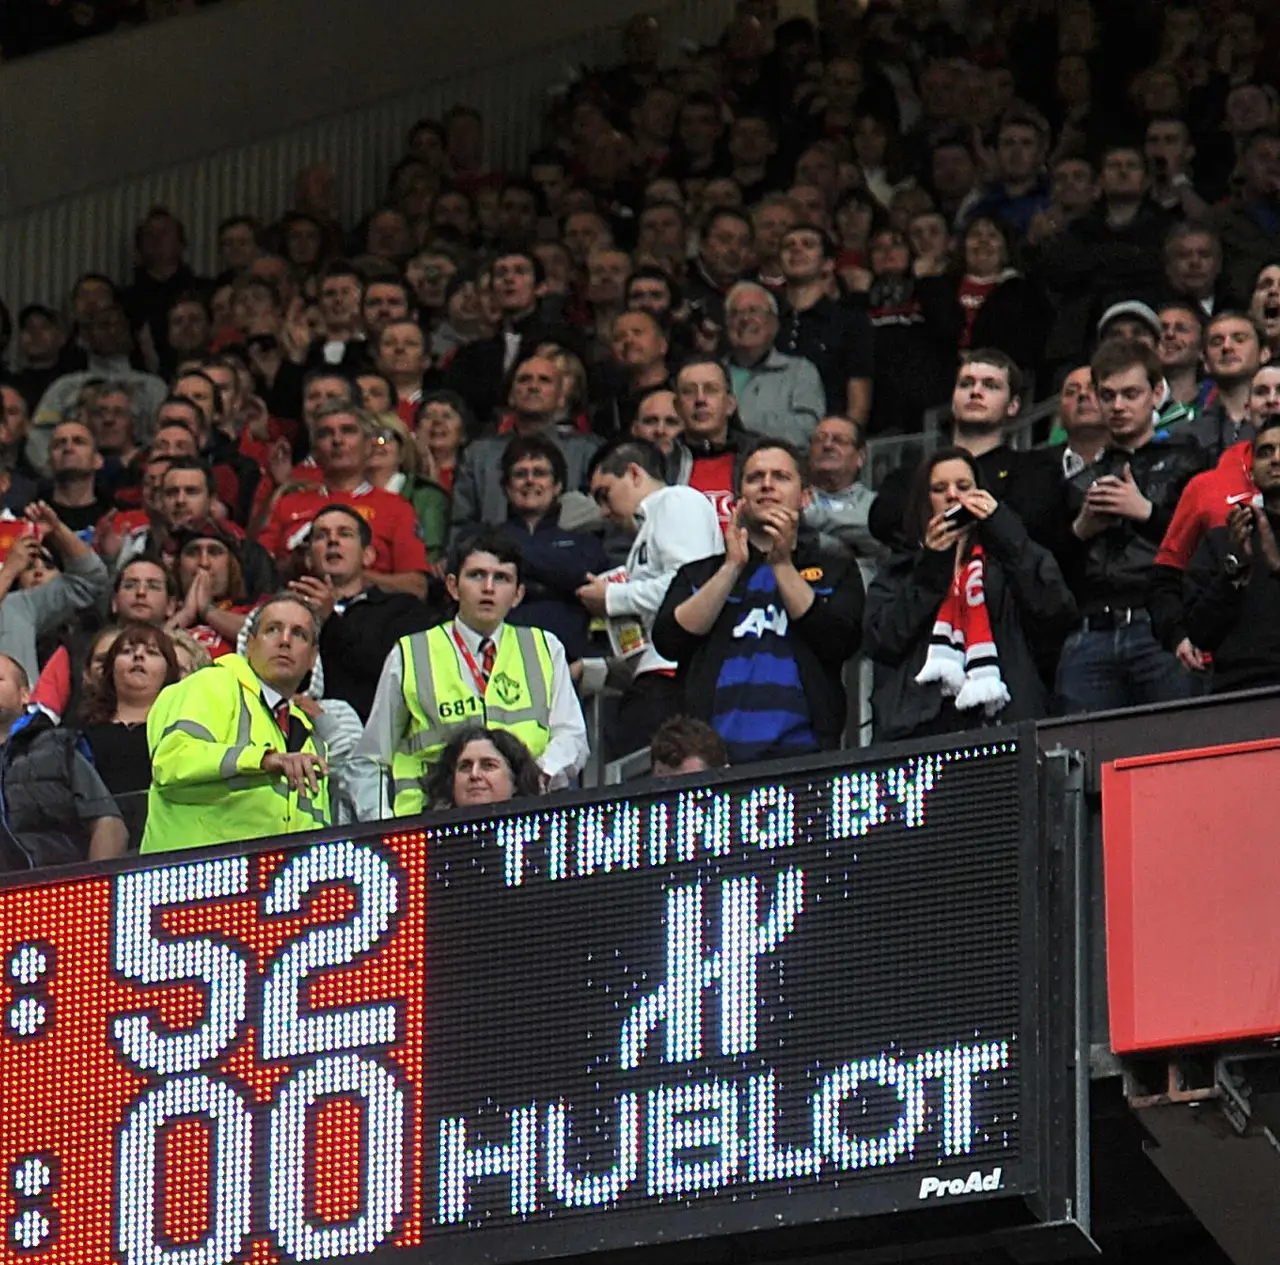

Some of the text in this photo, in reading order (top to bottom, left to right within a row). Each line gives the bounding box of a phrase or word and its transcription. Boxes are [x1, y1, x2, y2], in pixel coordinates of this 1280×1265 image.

[438, 696, 477, 718] 681
[496, 758, 940, 886] TIMING BY
[438, 1041, 1010, 1224] HUBLOT
[918, 1167, 1003, 1200] ProAd
